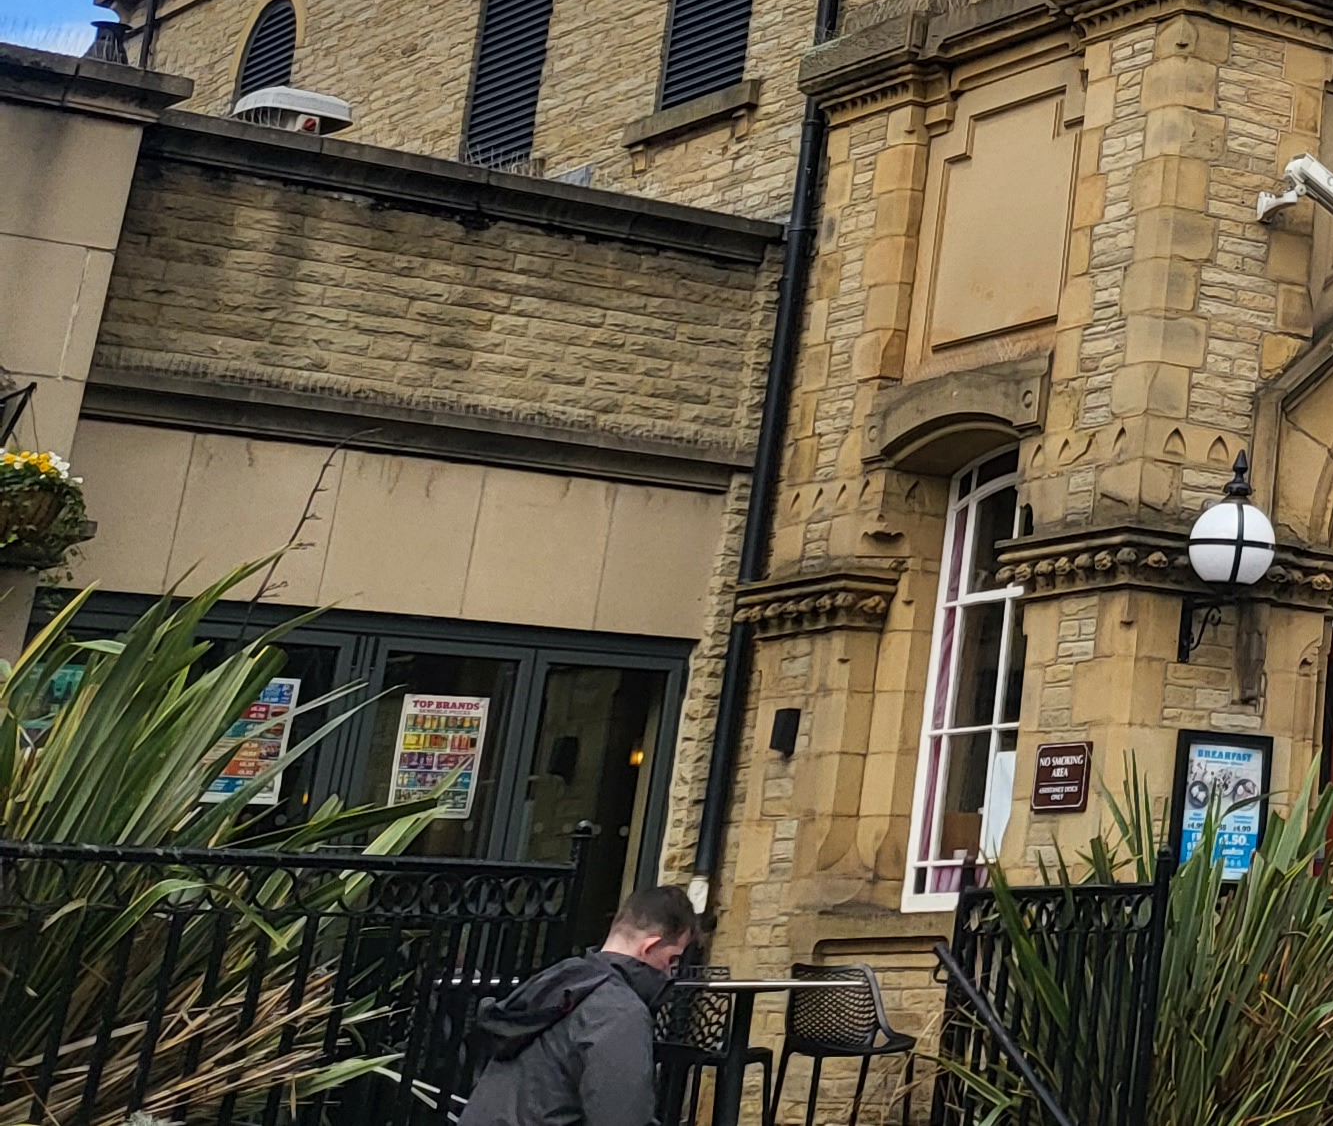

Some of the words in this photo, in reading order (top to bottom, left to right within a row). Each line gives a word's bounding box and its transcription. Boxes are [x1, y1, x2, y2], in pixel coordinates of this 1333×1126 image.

[412, 700, 434, 708] TOP
[435, 701, 480, 710] BRANDS
[1039, 757, 1051, 767] NO
[1052, 755, 1084, 766] SMOKING
[1197, 749, 1252, 762] BREAKFAST
[1051, 768, 1068, 778] AREA
